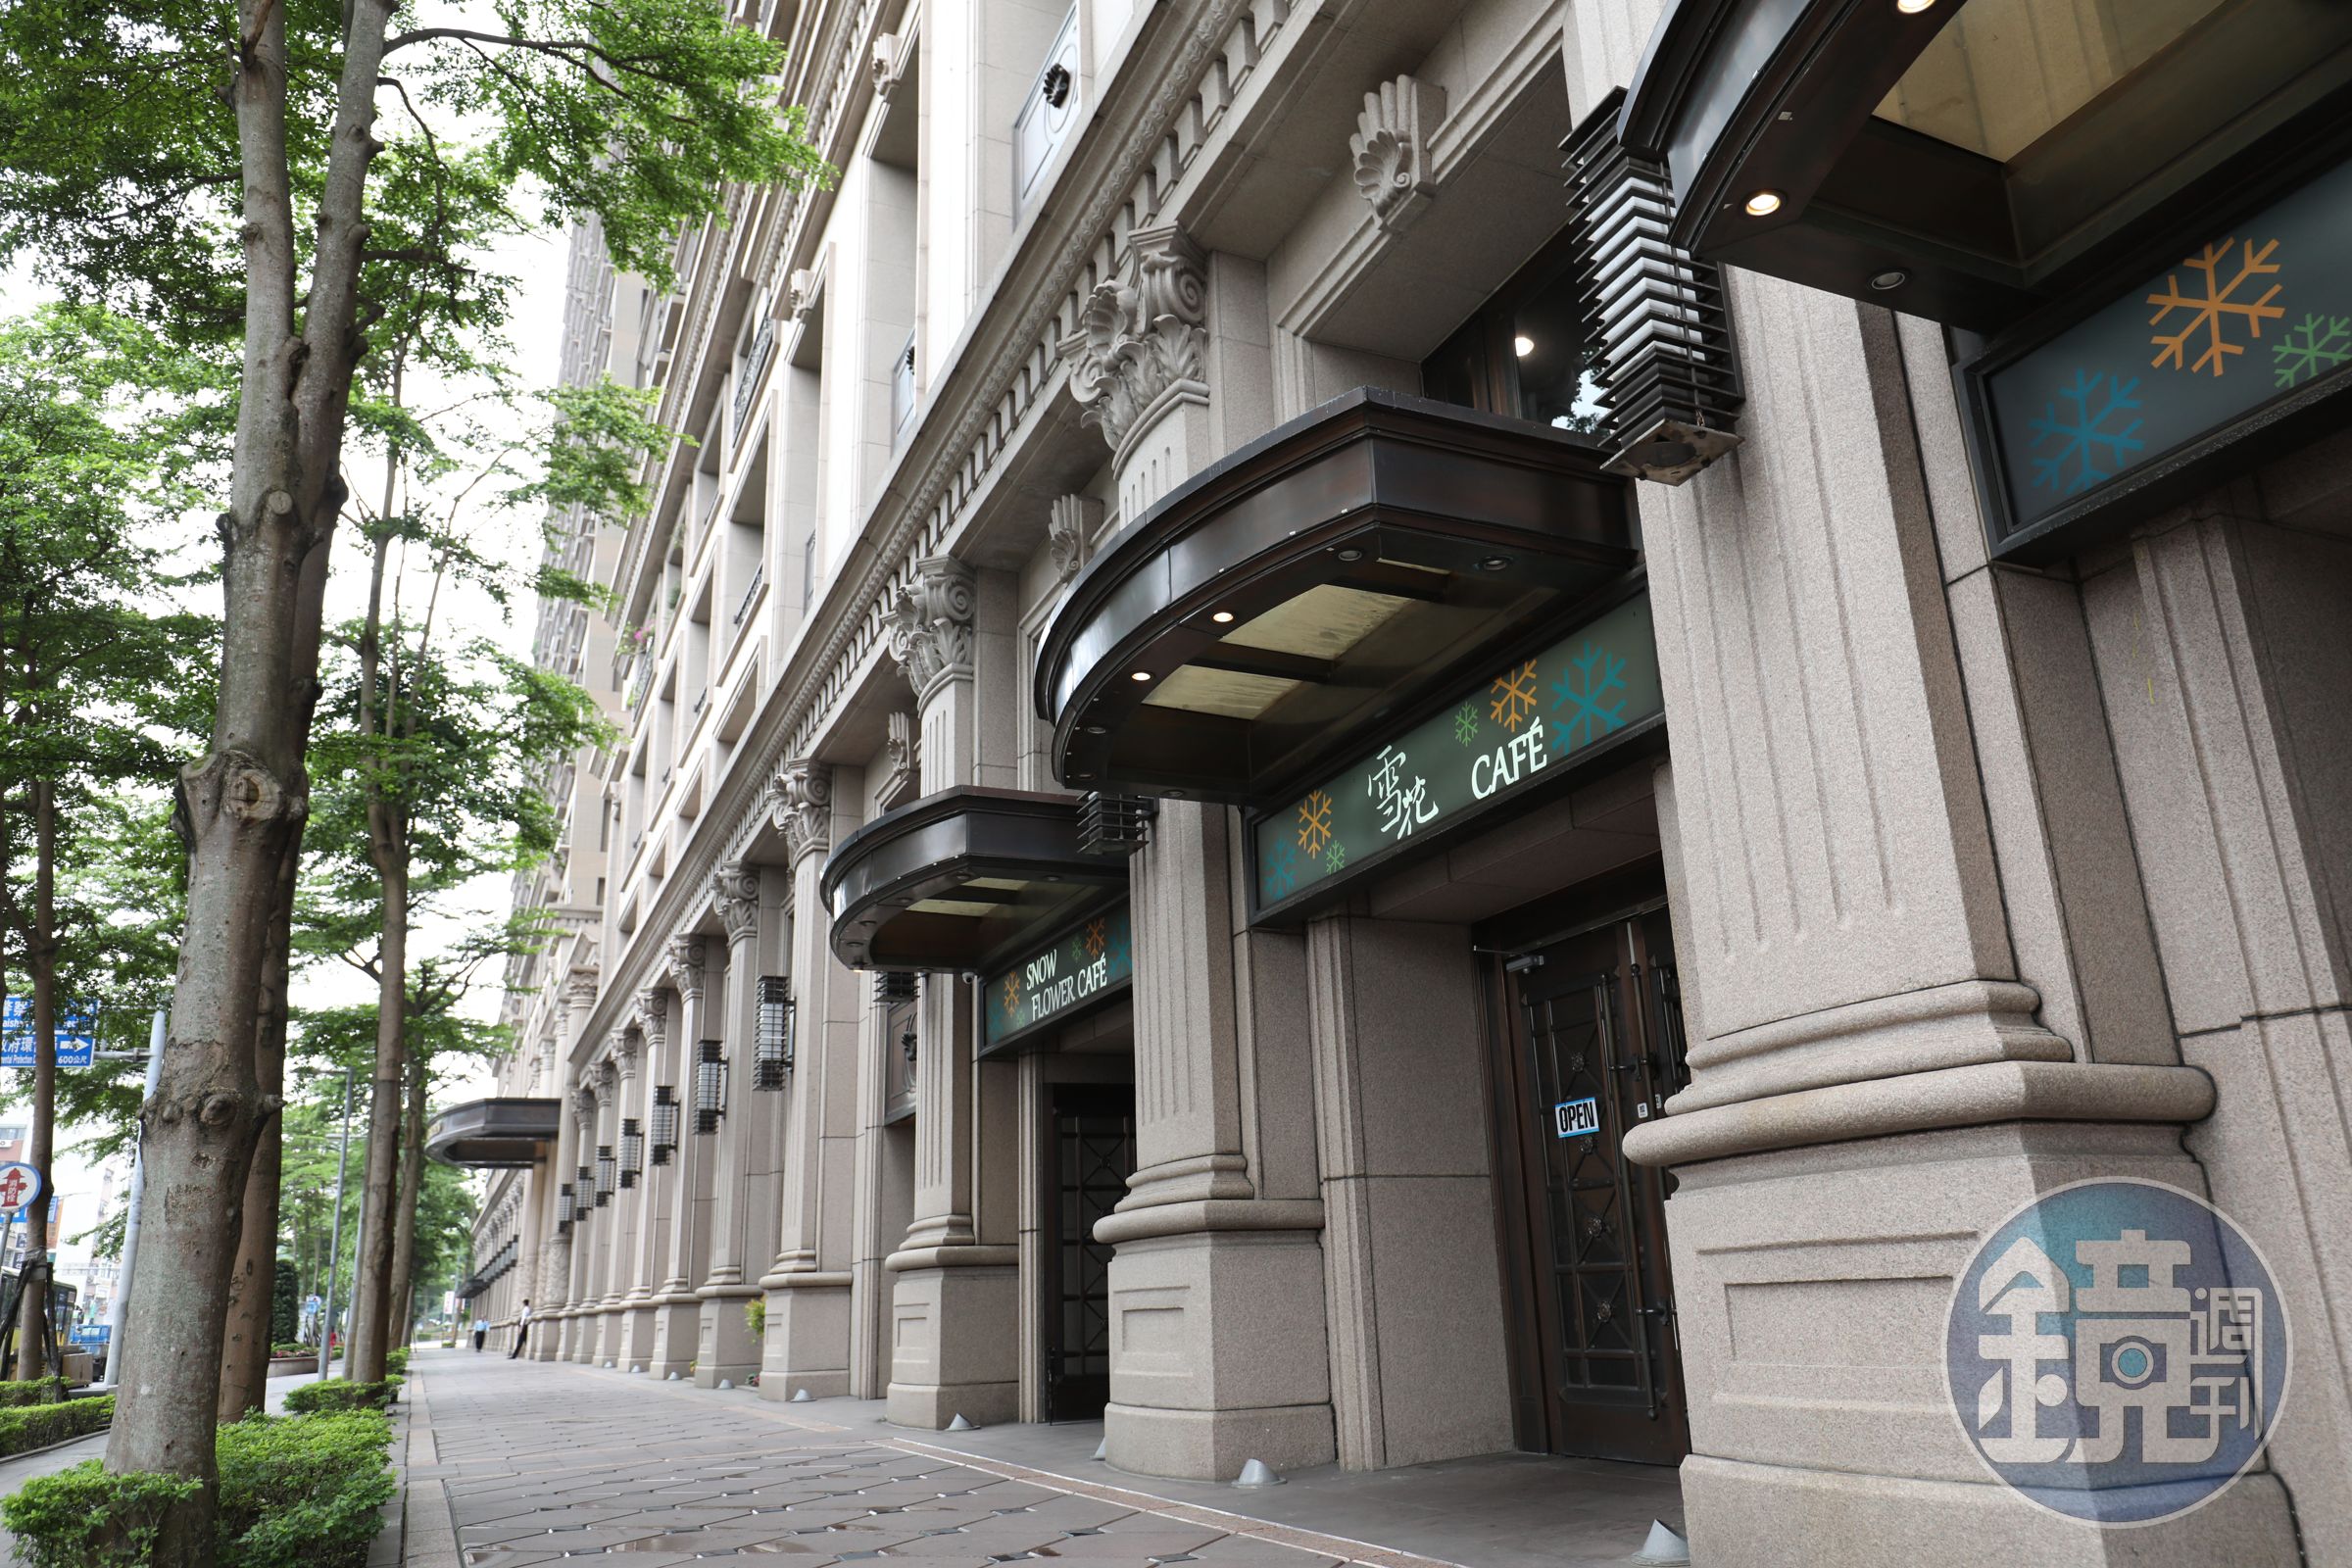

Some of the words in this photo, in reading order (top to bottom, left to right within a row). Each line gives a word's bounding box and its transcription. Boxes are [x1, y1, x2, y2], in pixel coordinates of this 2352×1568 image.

[1367, 745, 1439, 840] 雪花
[1471, 715, 1547, 800] CAFÉ
[1026, 948, 1057, 991] SNOW
[1032, 975, 1076, 1021] FLOWER
[1078, 952, 1107, 998] CAFÉ
[1558, 1101, 1595, 1133] OPEN
